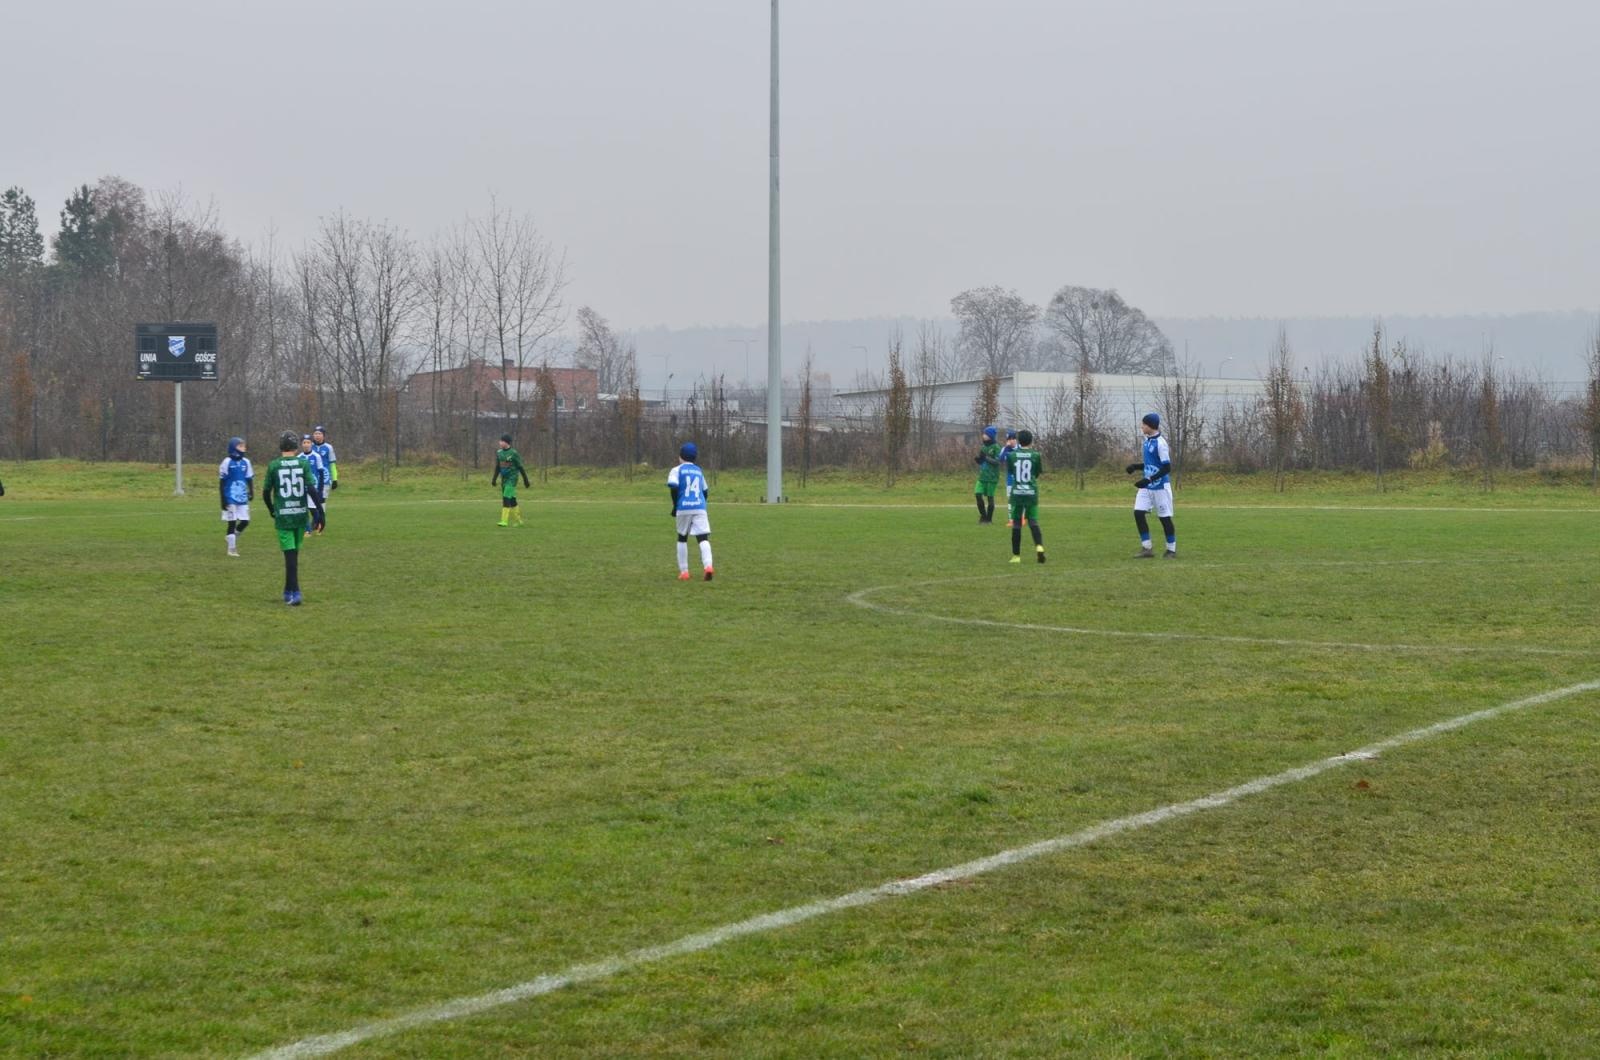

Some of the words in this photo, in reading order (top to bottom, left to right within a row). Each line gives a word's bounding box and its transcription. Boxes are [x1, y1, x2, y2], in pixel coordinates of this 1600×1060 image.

[140, 353, 157, 362] UNIA
[1013, 459, 1032, 482] 18
[278, 468, 304, 498] 55
[685, 475, 700, 498] 14
